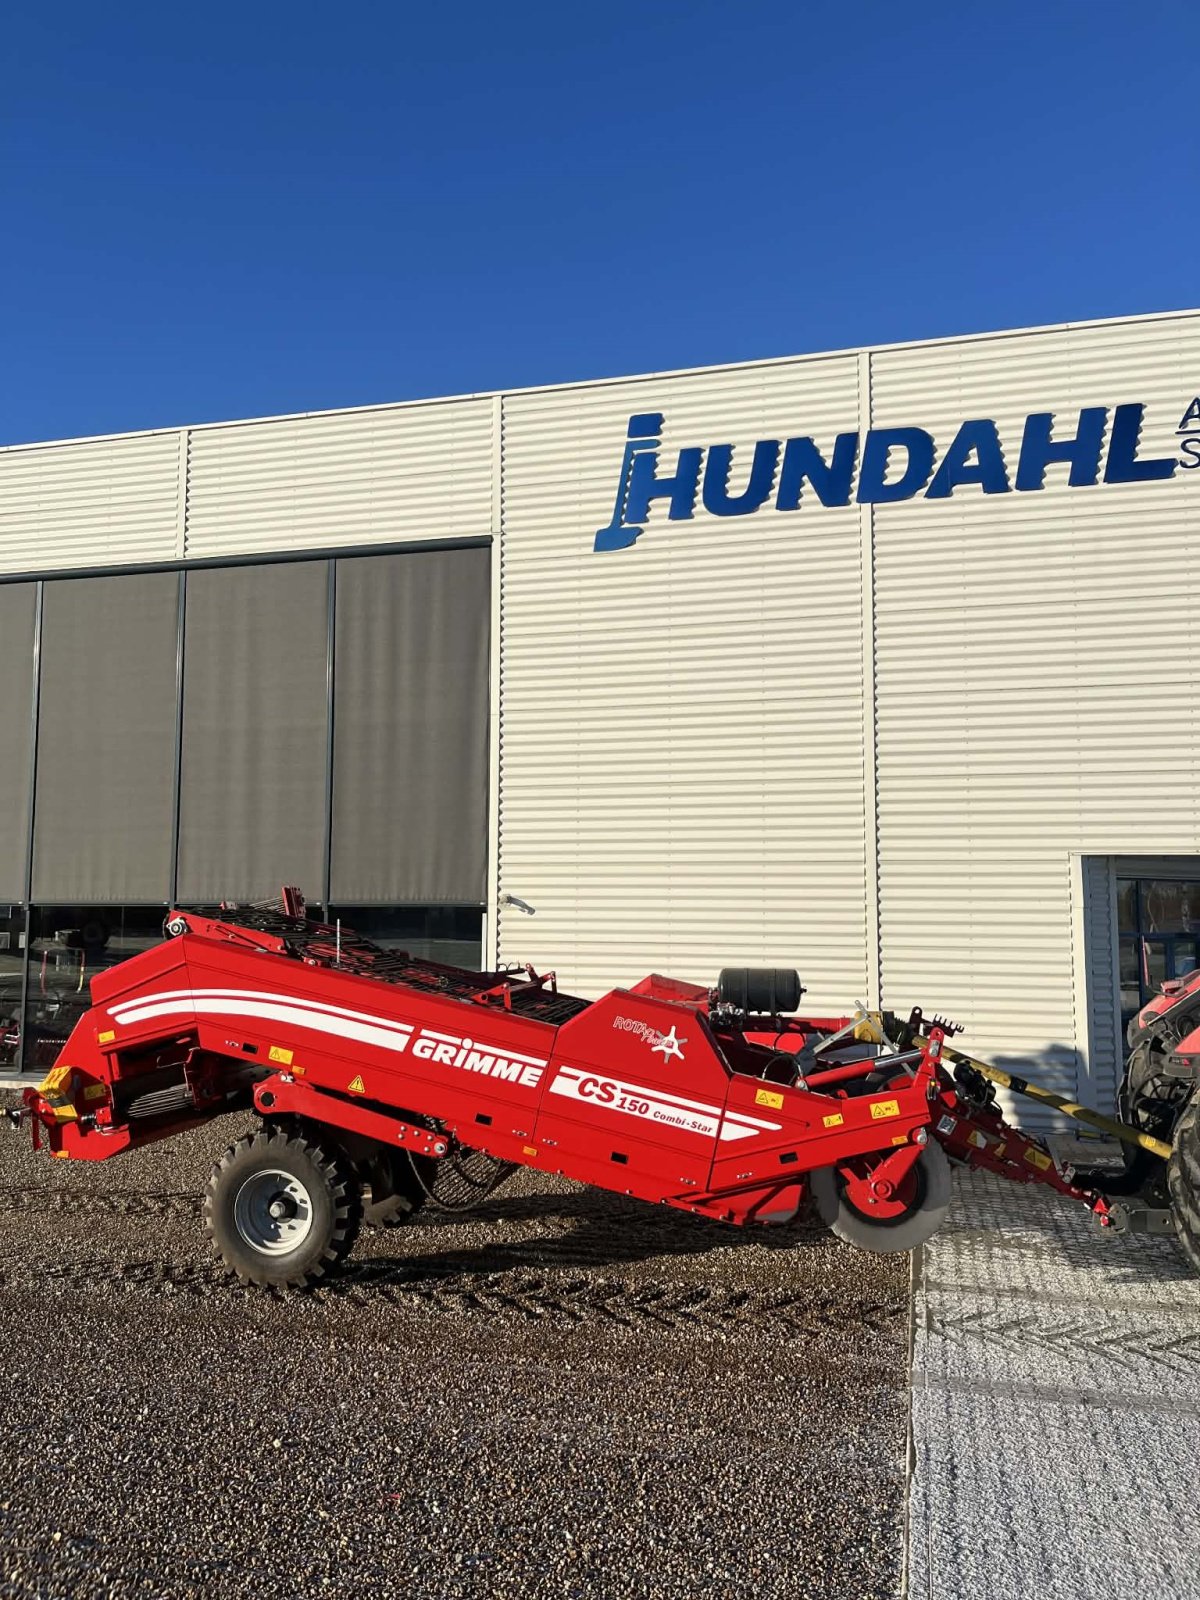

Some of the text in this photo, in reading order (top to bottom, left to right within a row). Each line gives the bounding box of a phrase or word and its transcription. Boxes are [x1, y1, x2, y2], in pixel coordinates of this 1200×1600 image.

[411, 1038, 544, 1088] GRIMME
[577, 1077, 618, 1103] CS
[615, 1096, 650, 1115] 150
